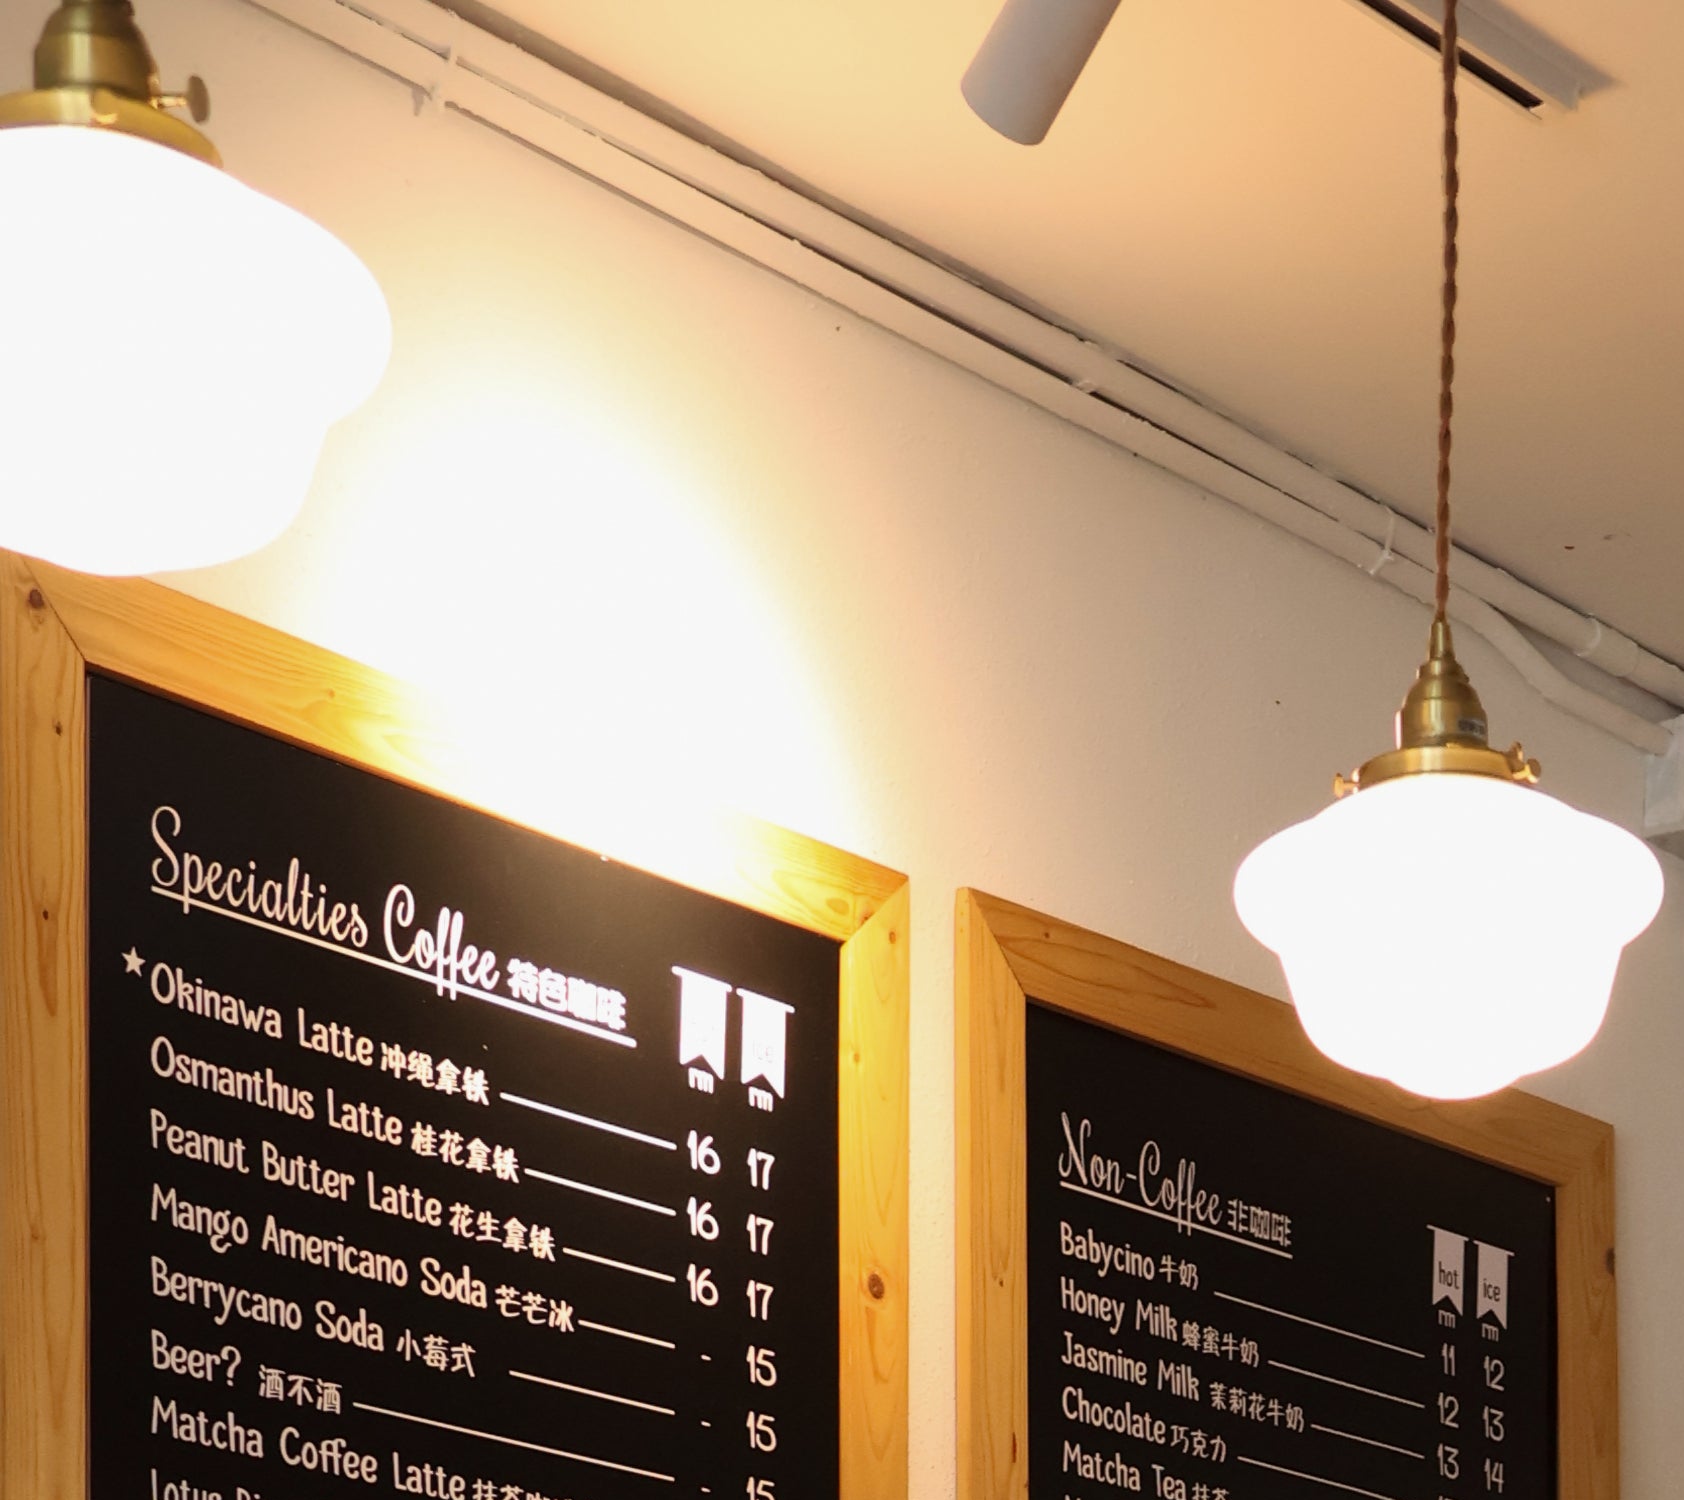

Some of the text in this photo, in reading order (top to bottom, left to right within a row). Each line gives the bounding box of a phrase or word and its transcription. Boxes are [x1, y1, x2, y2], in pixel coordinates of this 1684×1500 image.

[152, 805, 368, 948] Specialties
[384, 884, 499, 1000] Coffee
[150, 962, 776, 1191] Okinawa Latte 冲绳拿铁 16 17
[150, 1035, 775, 1256] Osmanthus Latte 桂花拿铁 16 17
[150, 1108, 774, 1321] Peanut Butter Latte 花生拿铁 16 17
[1059, 1112, 1292, 1247] Non-Coffee 非咖啡
[150, 1255, 777, 1452] Berrycano Soda 小莓式 15
[151, 1183, 777, 1387] Mango Americano Soda 芒芒冰 15
[1060, 1221, 1456, 1377] Babycino 牛奶 11
[1060, 1276, 1125, 1335] Honey
[1135, 1299, 1178, 1342] Milk
[1437, 1392, 1459, 1429] 12
[1439, 1262, 1502, 1302] hot ice
[151, 1328, 242, 1387] Beer?
[258, 1364, 343, 1415] 酒不酒
[151, 1395, 264, 1458] Matcha
[279, 1426, 378, 1484] Coffee
[1061, 1330, 1460, 1480] Jasmine Milk 茉莉花牛奶 13
[1062, 1386, 1166, 1445] Chocolate
[1170, 1424, 1227, 1463] 巧克力
[1062, 1440, 1141, 1492] Matcha
